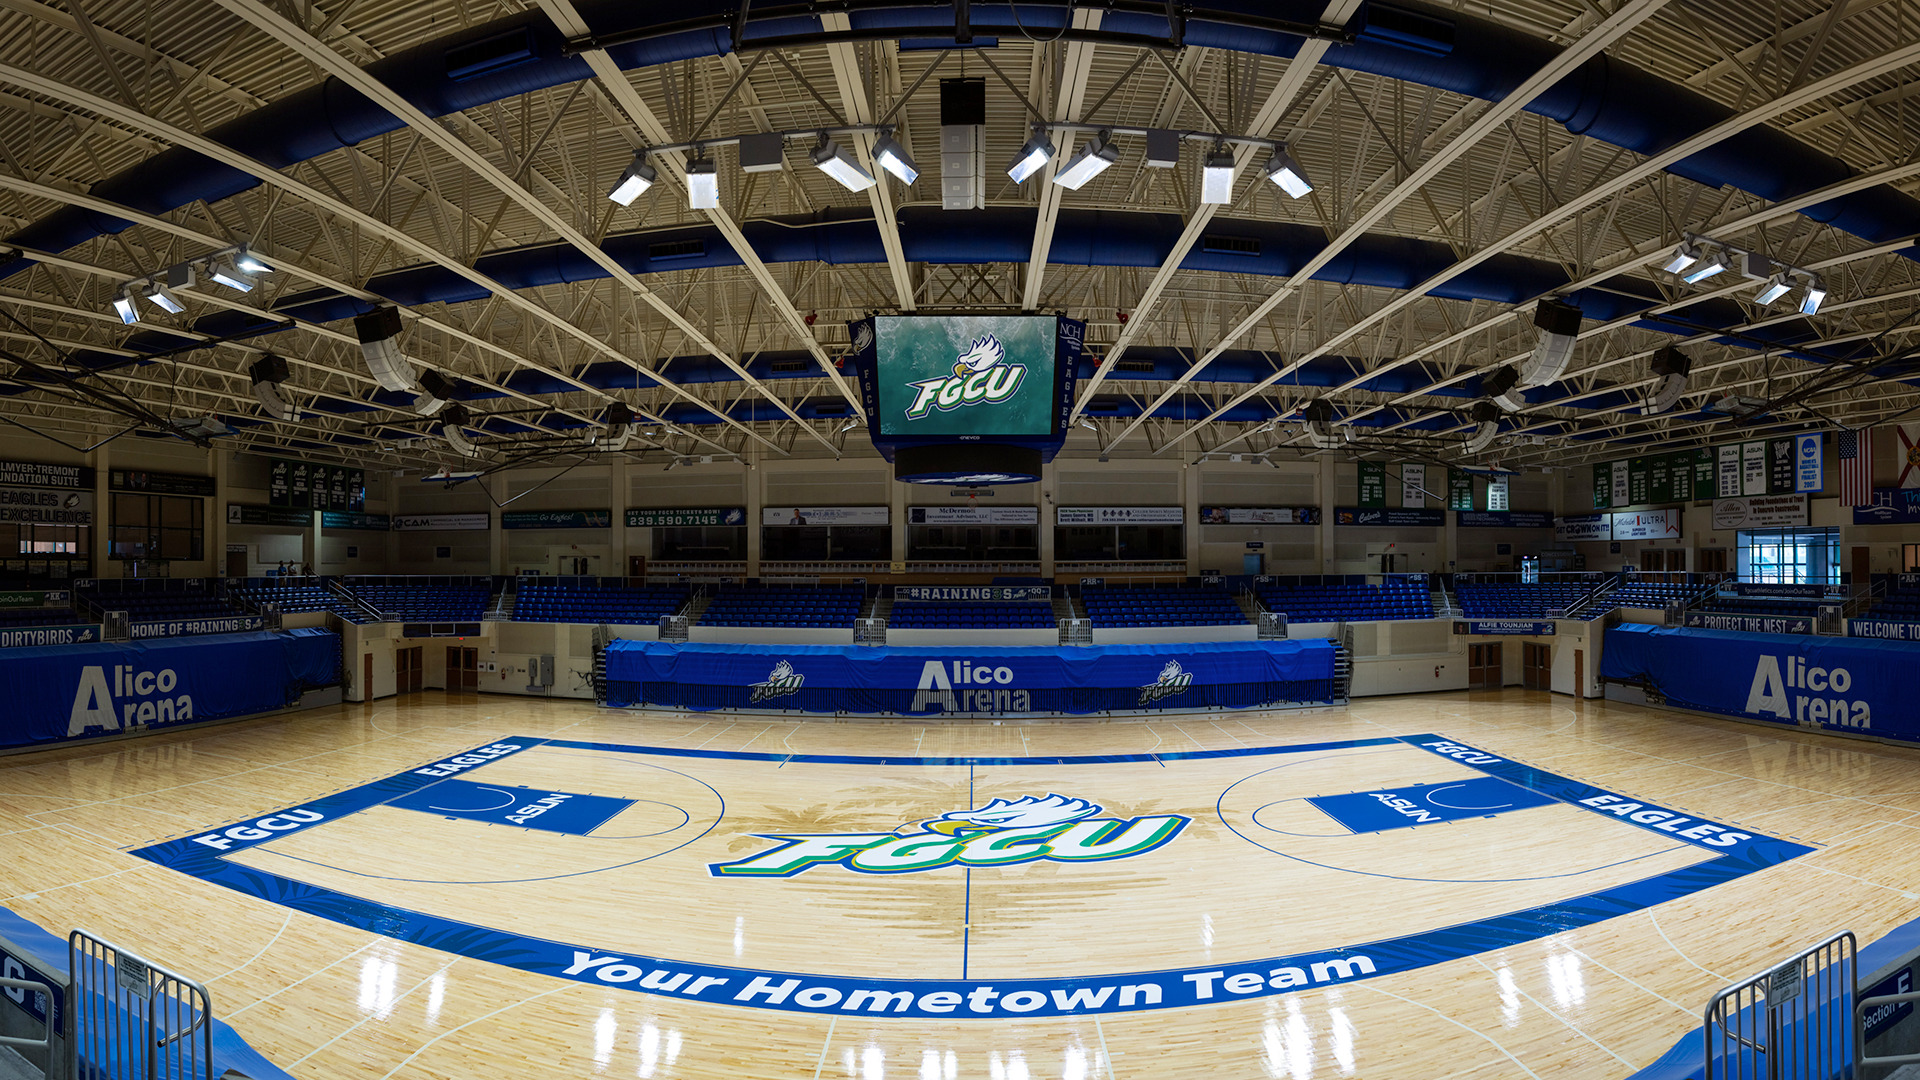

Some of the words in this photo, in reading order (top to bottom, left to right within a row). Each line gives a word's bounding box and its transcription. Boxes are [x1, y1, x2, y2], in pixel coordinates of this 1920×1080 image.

[1060, 323, 1080, 339] NCH
[864, 369, 874, 417] FGCU
[905, 363, 1028, 420] FGCU
[1061, 356, 1073, 429] EAGLES
[1721, 449, 1738, 457] ASUN
[1746, 446, 1763, 454] ASUN
[51, 475, 79, 487] SUITE
[1, 491, 59, 507] EAGLES
[0, 508, 91, 524] EXCELLENCE
[404, 518, 430, 527] CAM
[539, 513, 549, 521] Go
[630, 515, 717, 526] 239.590.7145
[1641, 515, 1666, 525] ULTRA
[1556, 526, 1565, 534] GET
[1592, 524, 1600, 532] ON
[910, 587, 1012, 600] #RAINING3S
[131, 623, 166, 638] HOME
[168, 622, 183, 635] OF
[1704, 615, 1742, 631] PROTECT
[1744, 616, 1761, 632] THE
[1763, 618, 1787, 634] NEST
[1853, 620, 1905, 639] WELCOME
[1908, 624, 1920, 640] TO
[1, 628, 74, 648] DIRTYBIRDS
[910, 661, 1013, 712] Alico
[1745, 654, 1851, 719] Alico
[67, 665, 177, 737] Alico
[414, 741, 523, 779] EAGLES
[1421, 741, 1501, 767] FGCU
[503, 791, 574, 826] ASUN
[1367, 792, 1442, 825] ASUN
[190, 807, 327, 852] FGCU
[1578, 793, 1753, 848] EAGLES
[707, 813, 1194, 878] FGCU
[562, 950, 727, 998] Your
[733, 976, 1163, 1014] Hometown
[1183, 951, 1376, 999] Team
[1863, 1003, 1895, 1031] Section
